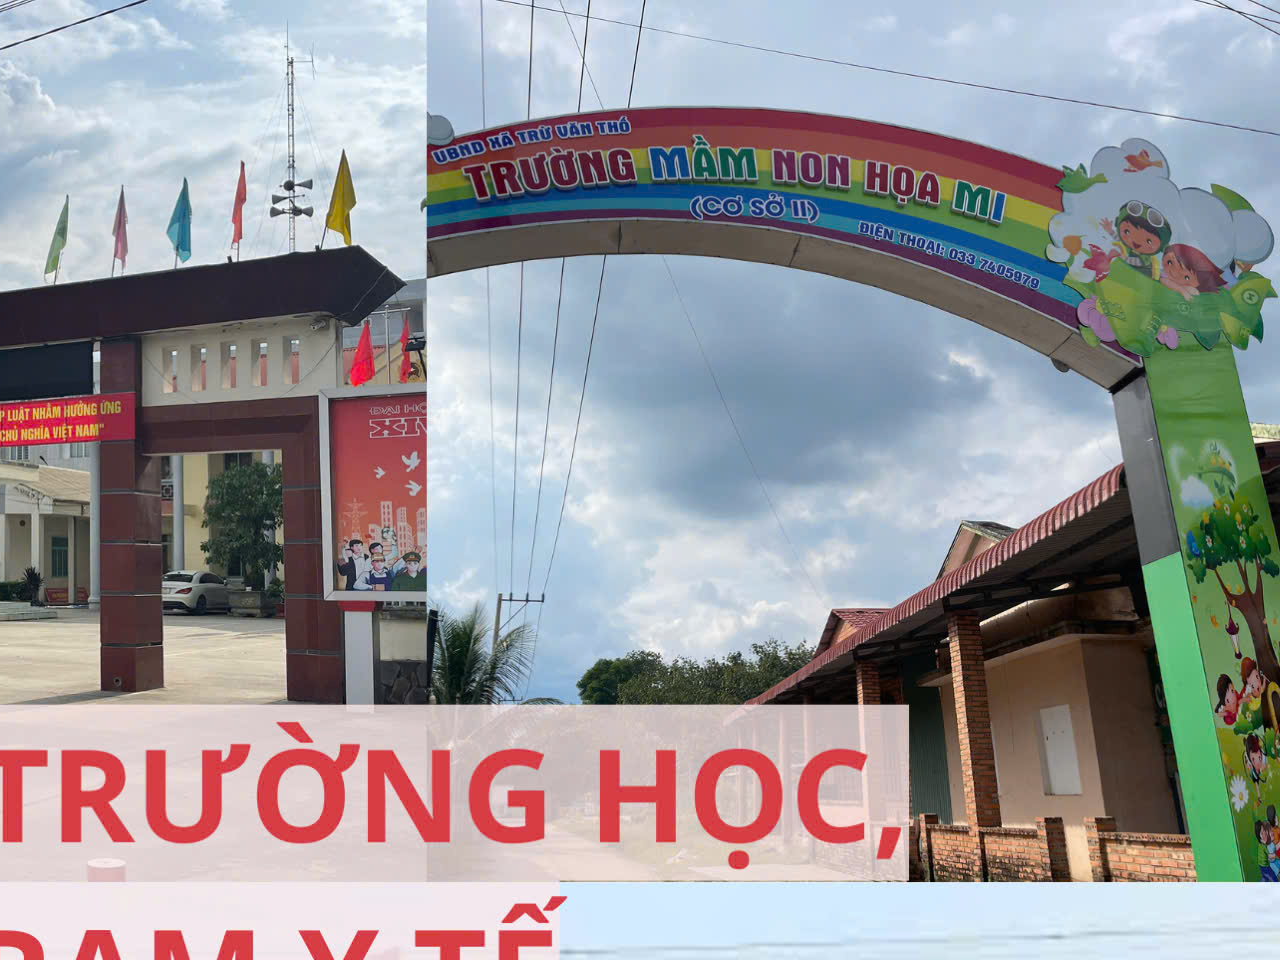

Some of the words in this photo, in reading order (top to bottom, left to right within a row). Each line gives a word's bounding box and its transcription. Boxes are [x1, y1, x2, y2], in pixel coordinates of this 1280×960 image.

[432, 140, 486, 164] UBND
[487, 131, 516, 151] XÃ
[516, 124, 553, 145] TRỪ
[556, 120, 593, 139] VĂN
[596, 116, 631, 135] THỐ
[463, 148, 637, 201] TRƯỜNG
[648, 134, 759, 183] MẦM
[771, 148, 851, 190] NON
[864, 160, 941, 207] HỌA
[952, 180, 1007, 224] MI
[689, 195, 743, 221] (CƠ
[749, 193, 785, 219] SỞ
[791, 198, 820, 224] II)
[858, 220, 894, 242] ĐIỆN
[898, 231, 946, 258] THOẠI:
[949, 248, 976, 267] 033
[979, 257, 1040, 290] 7405979
[7, 407, 29, 423] LUẬT
[100, 400, 121, 414] ỨNG
[0, 426, 18, 441] CHỦ
[52, 424, 73, 441] VIỆT
